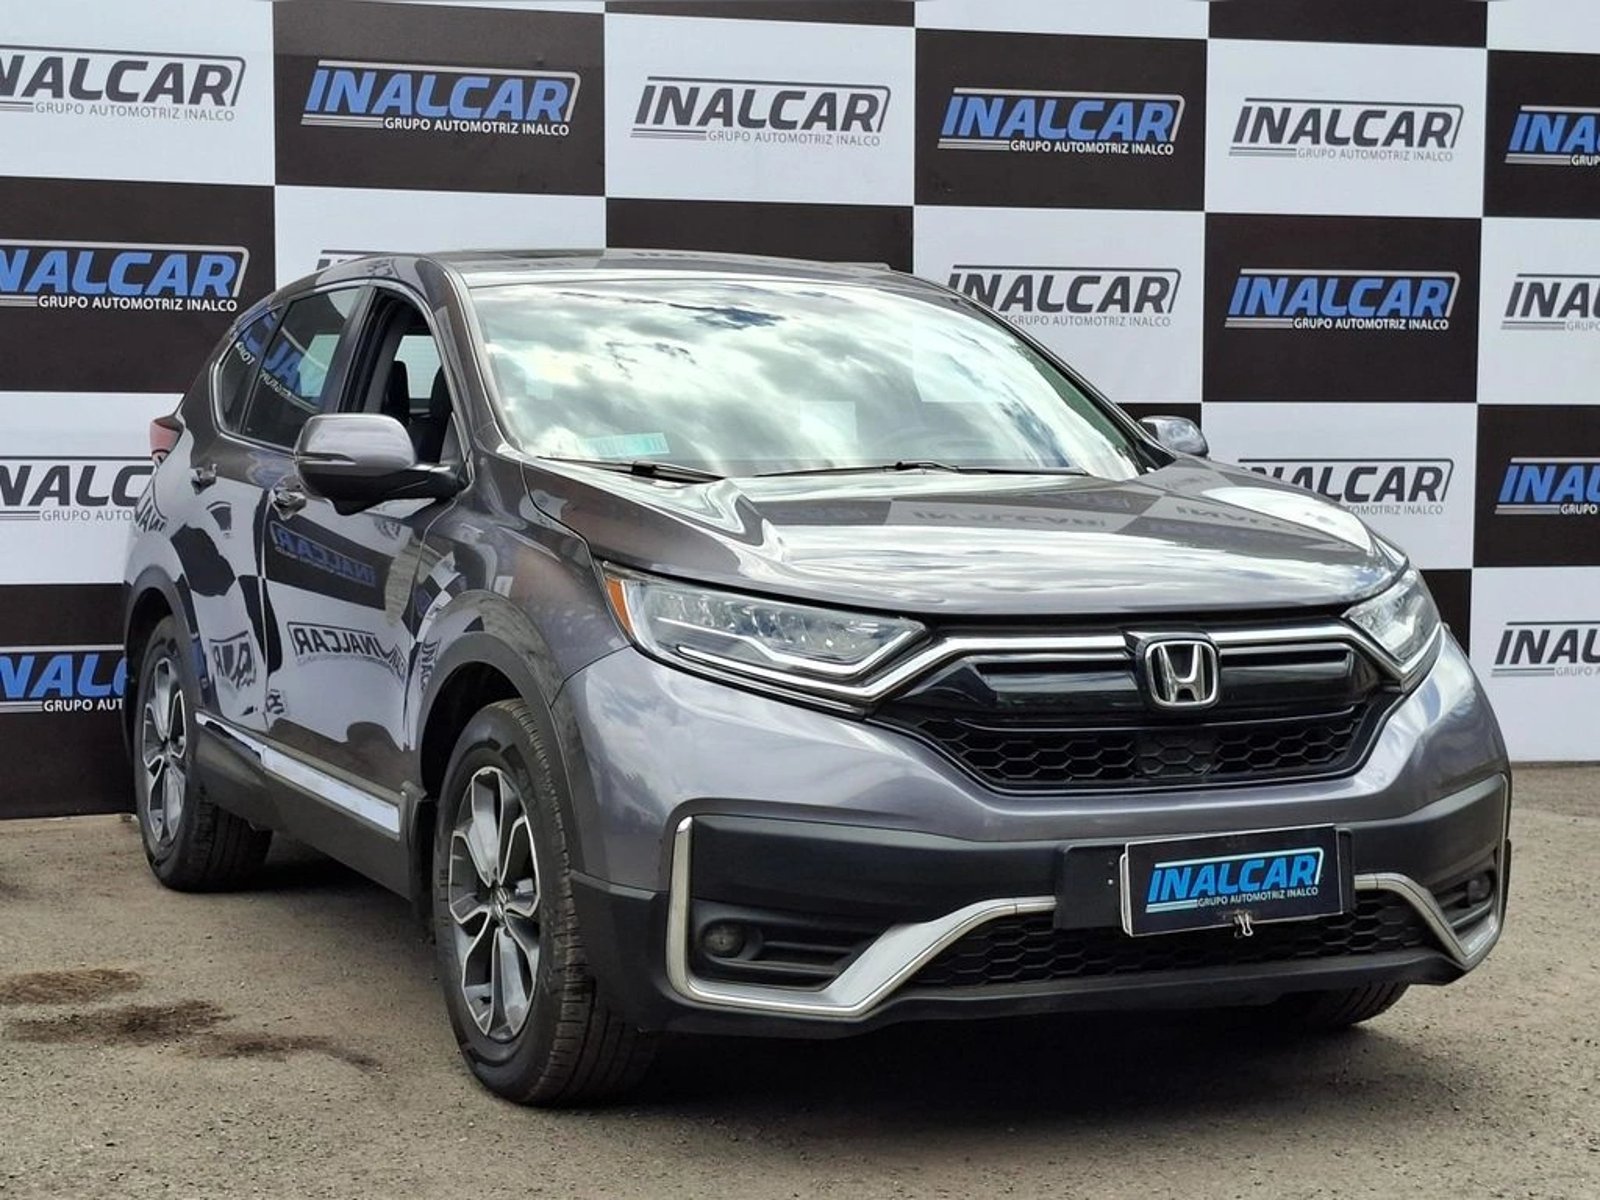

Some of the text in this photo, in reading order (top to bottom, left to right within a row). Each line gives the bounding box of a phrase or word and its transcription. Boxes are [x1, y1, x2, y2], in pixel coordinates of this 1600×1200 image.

[305, 69, 568, 121] INALCAR
[35, 102, 235, 122] GRUPO AUTOMOTRIZ INALCO
[634, 85, 879, 133] INALCAR
[385, 117, 569, 136] GRUPO AUTOMOTRIZ INALCO
[941, 96, 1174, 142] INALCAR
[1232, 106, 1453, 148] INALCAR
[708, 130, 881, 147] GRUPO AUTOMOTRIZ INALCO
[1508, 113, 1600, 153] INA
[1010, 139, 1174, 156] GRUPO AUTOMOTRIZ INALCO
[1297, 147, 1453, 162] GRUPO AUTOMOTRIZ INALCO
[38, 295, 238, 313] GRUPO AUTOMOTRIZ INALCO
[1228, 276, 1449, 318] INALCAR
[1505, 282, 1600, 318] INA
[1010, 315, 1171, 327] GRUPO AUTOMOTRIZ INALCO
[1294, 317, 1449, 331] GRUPO AUTOMOTRIZ INALCO
[42, 510, 91, 522] GRUPO
[1404, 504, 1443, 516] INALCO
[1561, 504, 1598, 515] GRUPO
[1555, 667, 1592, 676] GRUPO
[44, 699, 93, 712] GRUPO
[1148, 855, 1316, 902] INALCAR
[1230, 890, 1285, 904] AUTOMOTRIZ
[1287, 887, 1318, 899] INALCO
